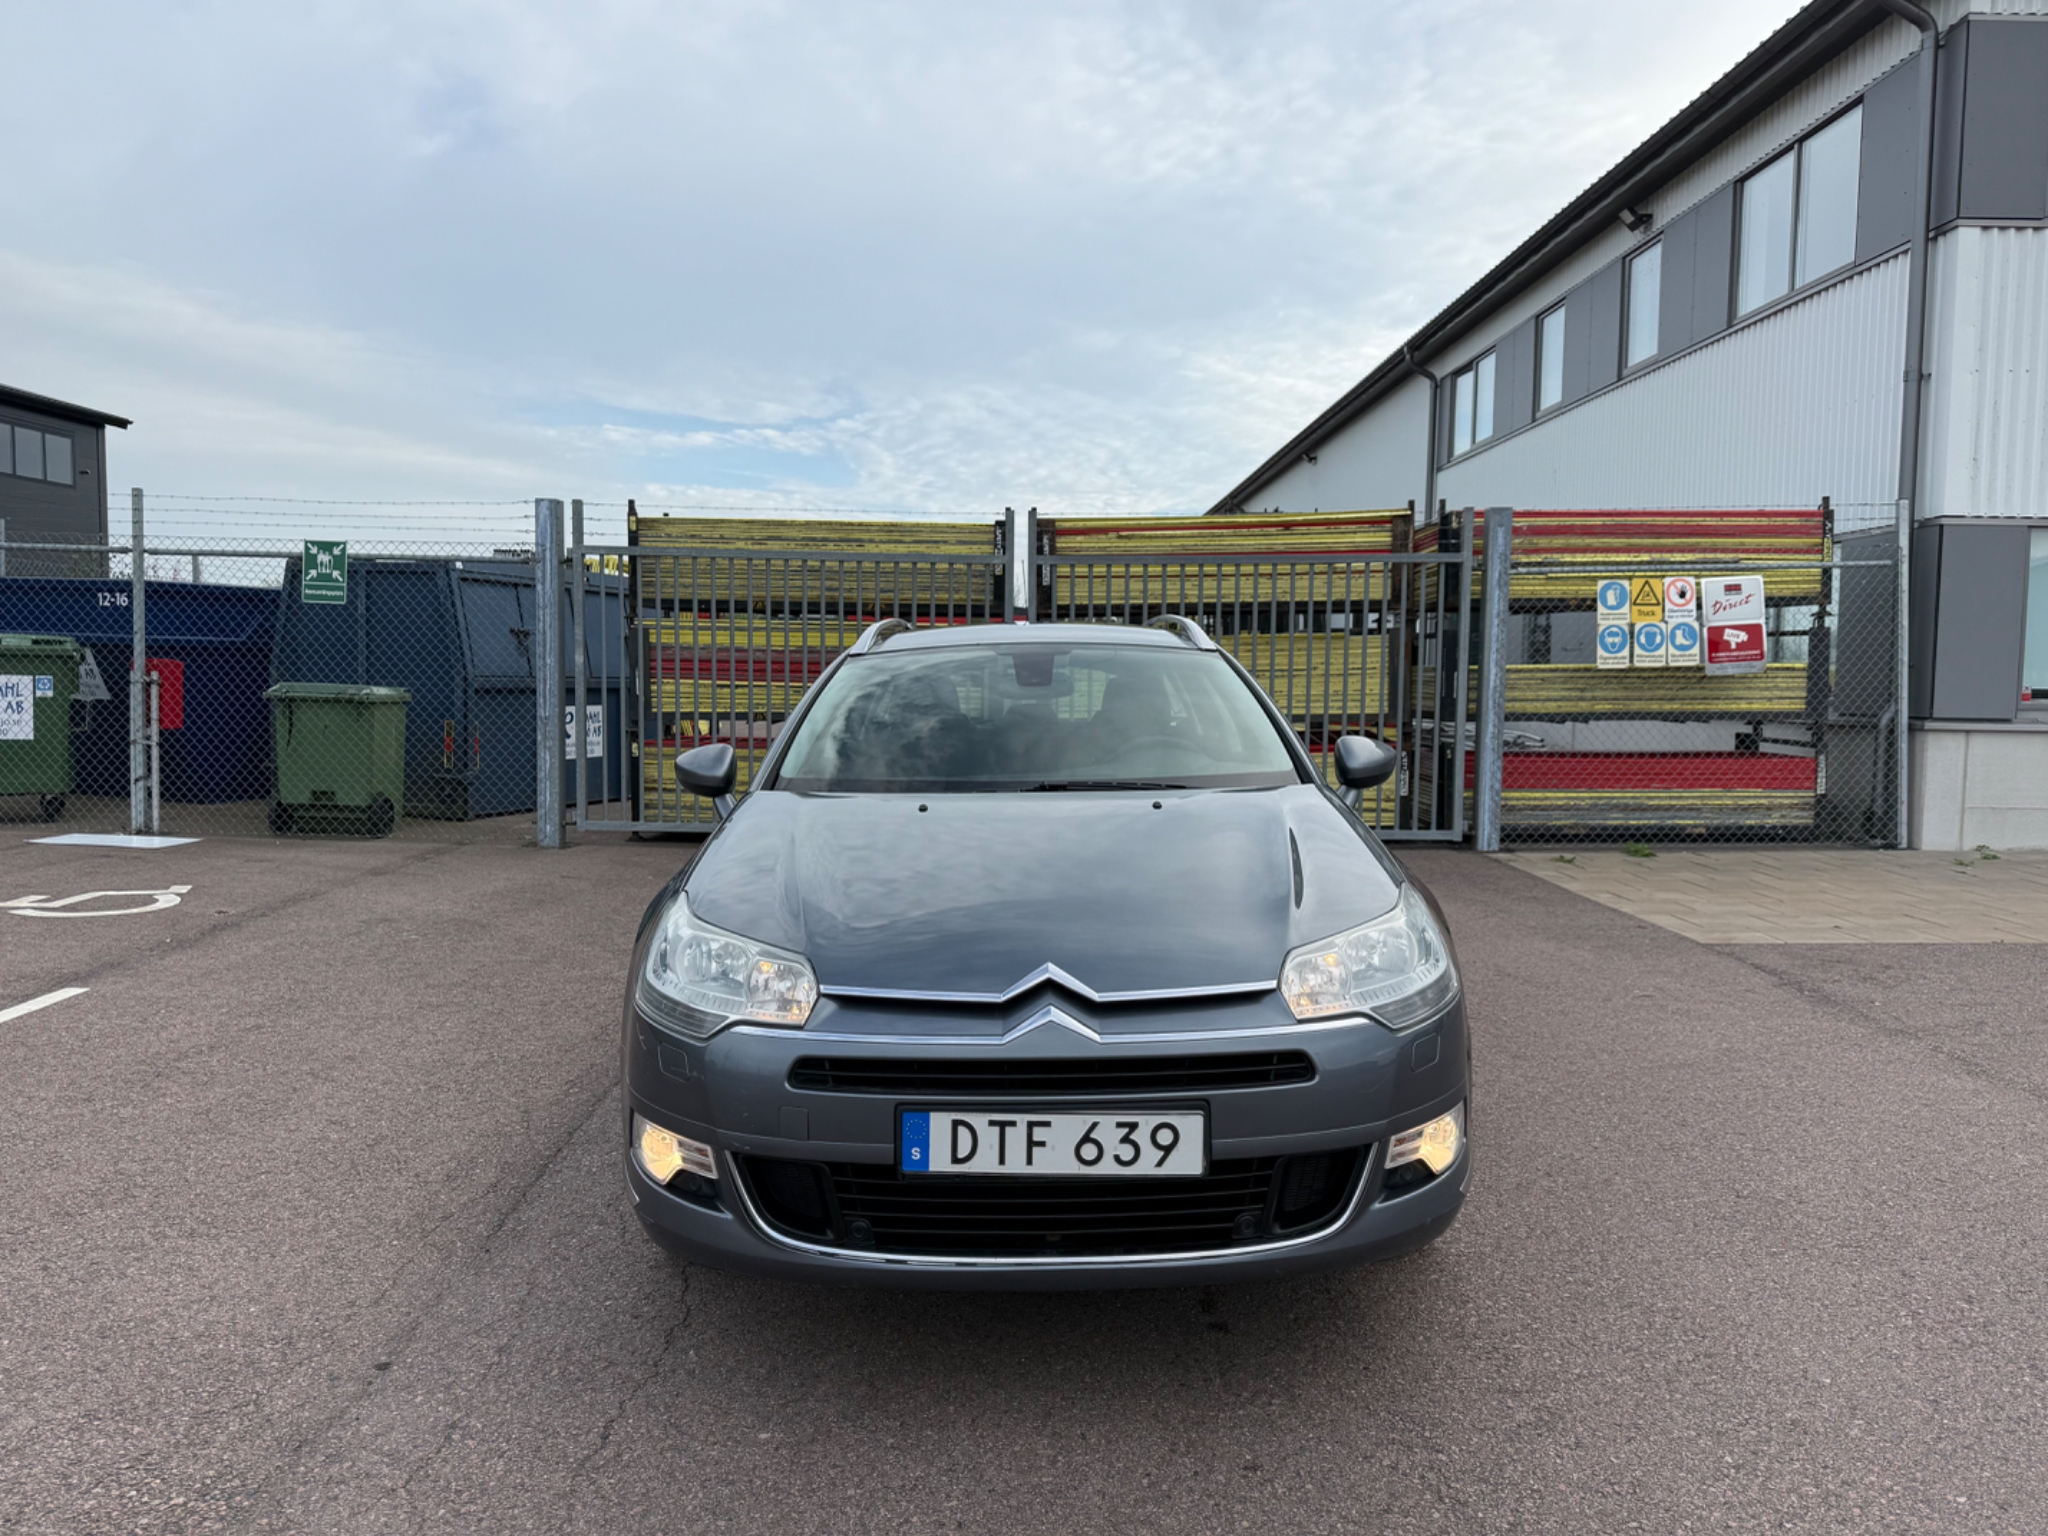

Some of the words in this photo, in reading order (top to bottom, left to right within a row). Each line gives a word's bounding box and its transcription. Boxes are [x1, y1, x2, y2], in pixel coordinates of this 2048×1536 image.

[97, 592, 129, 607] 12-16
[1637, 609, 1656, 618] Truck
[1726, 630, 1741, 640] LIVE
[4, 701, 24, 715] AB
[950, 1119, 1052, 1166] DTF
[1073, 1121, 1181, 1168] 639
[910, 1147, 921, 1161] S
